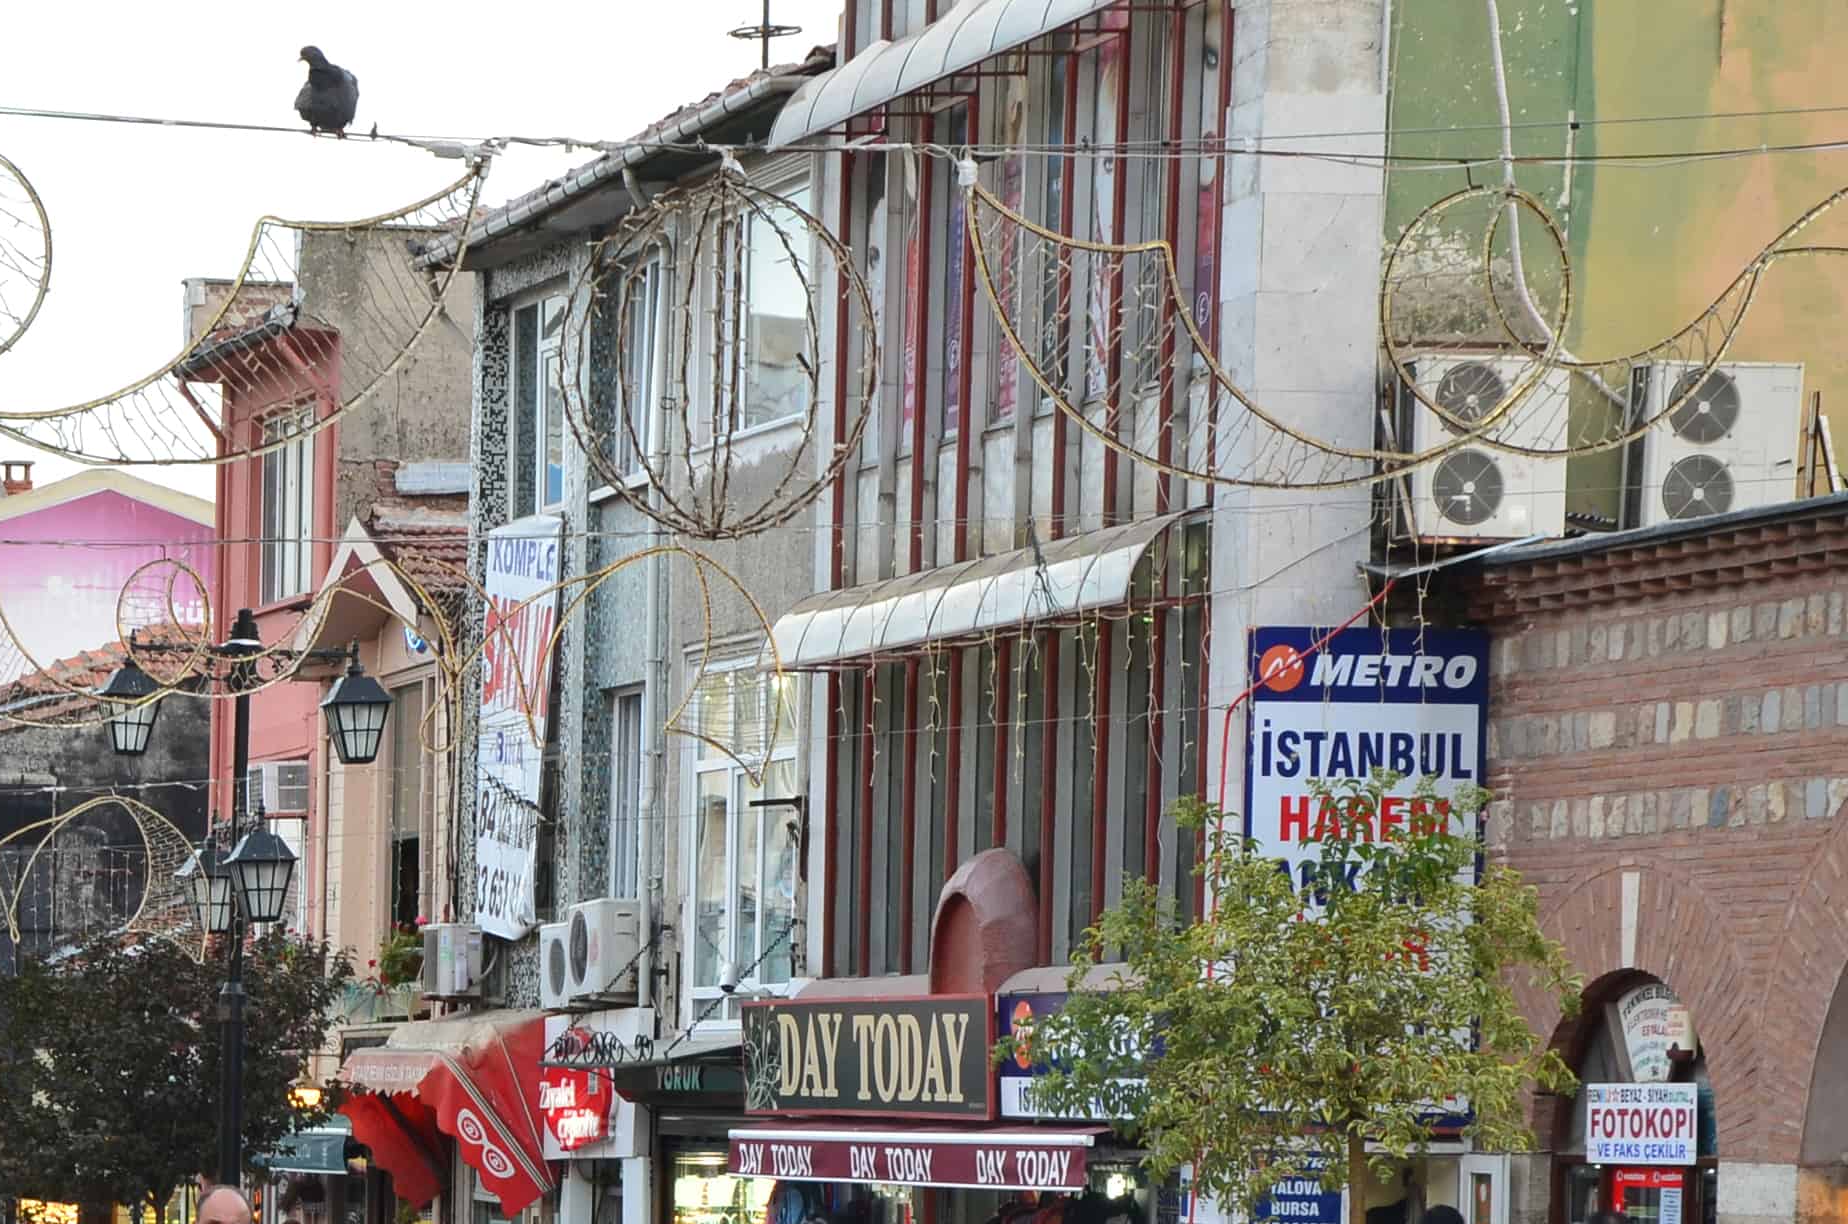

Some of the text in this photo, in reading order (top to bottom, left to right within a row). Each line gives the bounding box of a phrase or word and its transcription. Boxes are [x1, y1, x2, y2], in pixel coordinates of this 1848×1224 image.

[1309, 653, 1478, 690] METRO
[1261, 718, 1473, 780] İSTANBUL
[777, 1013, 843, 1098] DAY
[853, 1012, 970, 1104] TODAY
[738, 1143, 813, 1176] DAY TODAY
[849, 1145, 933, 1182] DAY TODAY
[975, 1149, 1071, 1186] DAY TODAY
[1597, 1143, 1611, 1158] VE
[1614, 1142, 1641, 1158] FAKS
[1271, 1201, 1320, 1217] BURSA
